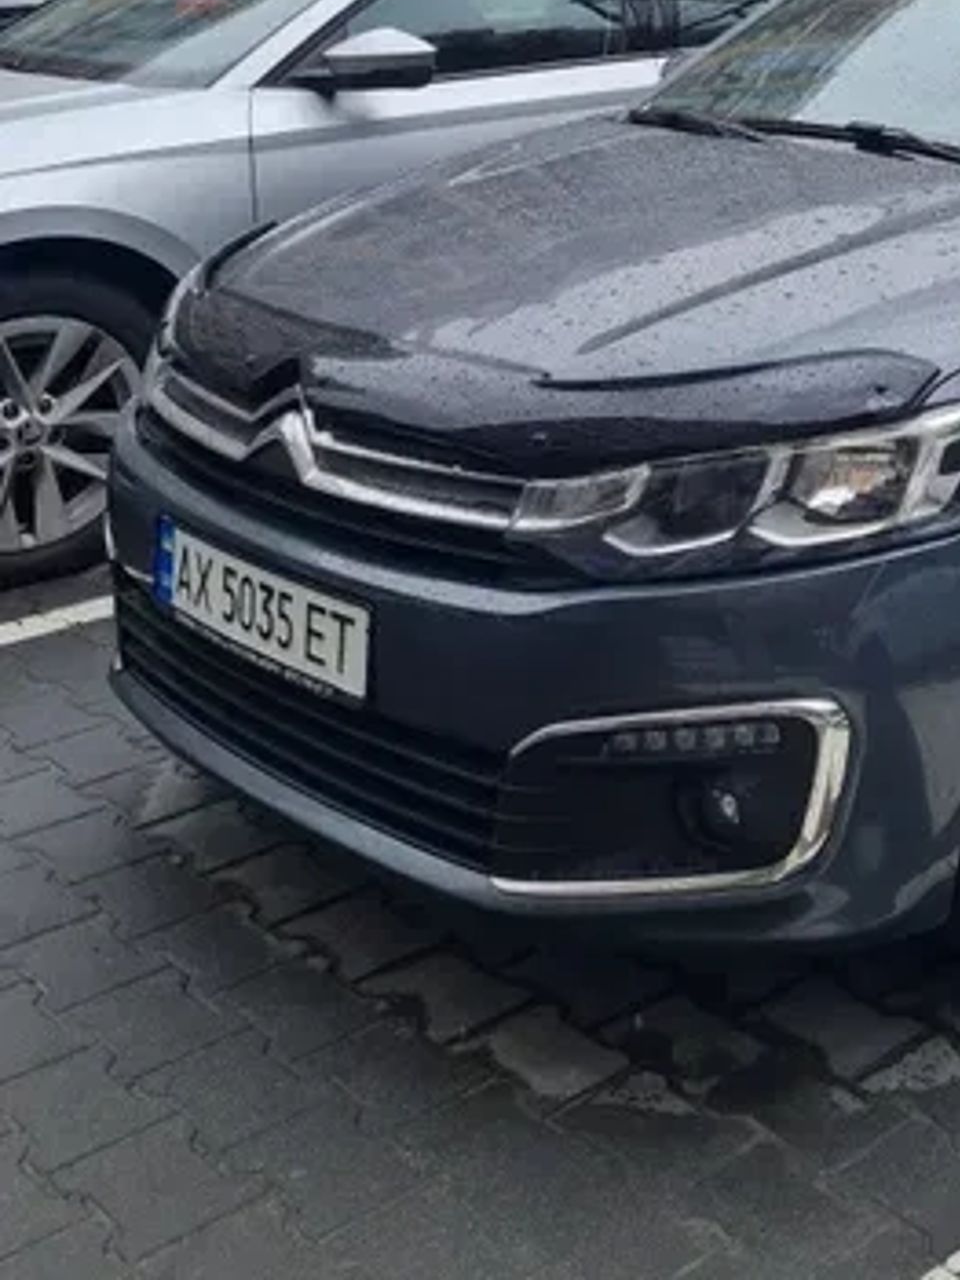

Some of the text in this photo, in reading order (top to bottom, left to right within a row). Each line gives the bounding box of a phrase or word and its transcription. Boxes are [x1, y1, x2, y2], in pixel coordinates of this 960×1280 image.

[177, 547, 213, 614] AX
[221, 565, 294, 650] 5035
[305, 602, 356, 674] ET
